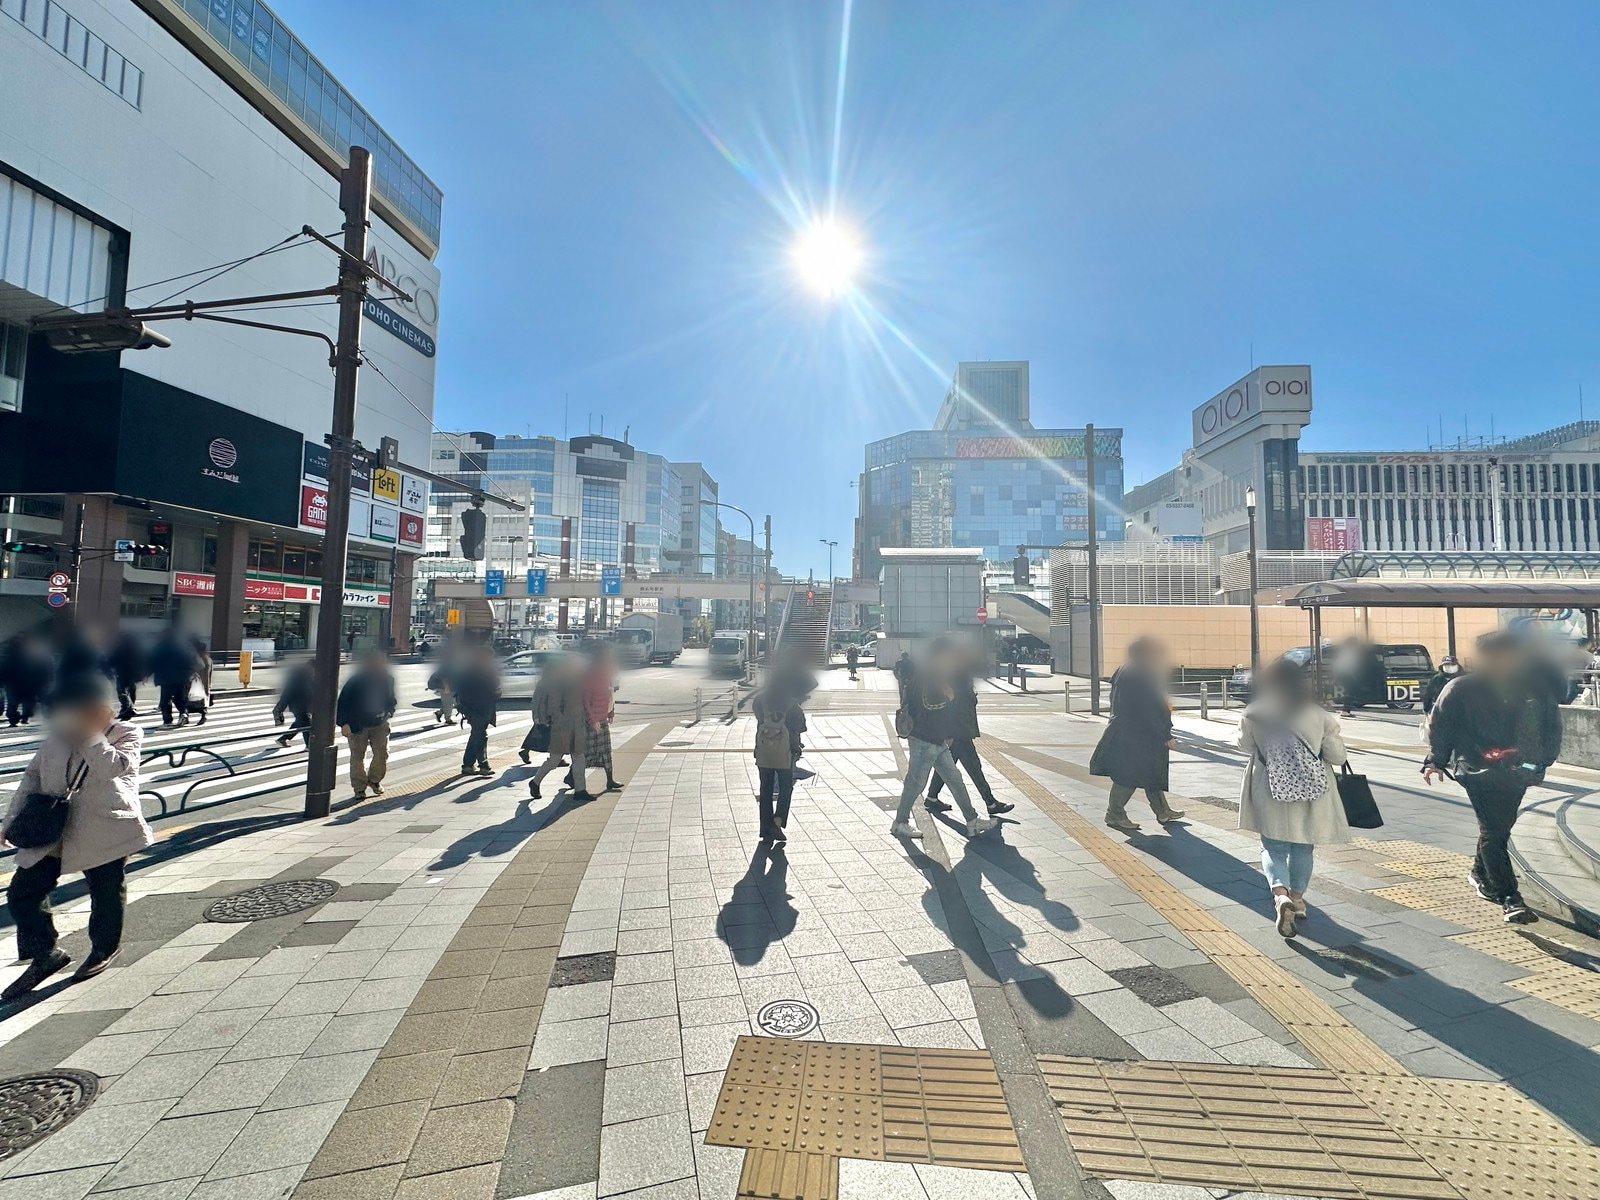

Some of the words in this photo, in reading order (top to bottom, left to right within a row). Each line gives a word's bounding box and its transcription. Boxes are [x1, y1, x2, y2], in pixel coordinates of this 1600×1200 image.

[365, 247, 437, 326] ARCO
[363, 300, 390, 325] TOHO
[391, 320, 433, 353] CINEMAS
[177, 577, 196, 587] SBC
[1387, 685, 1421, 701] IDE
